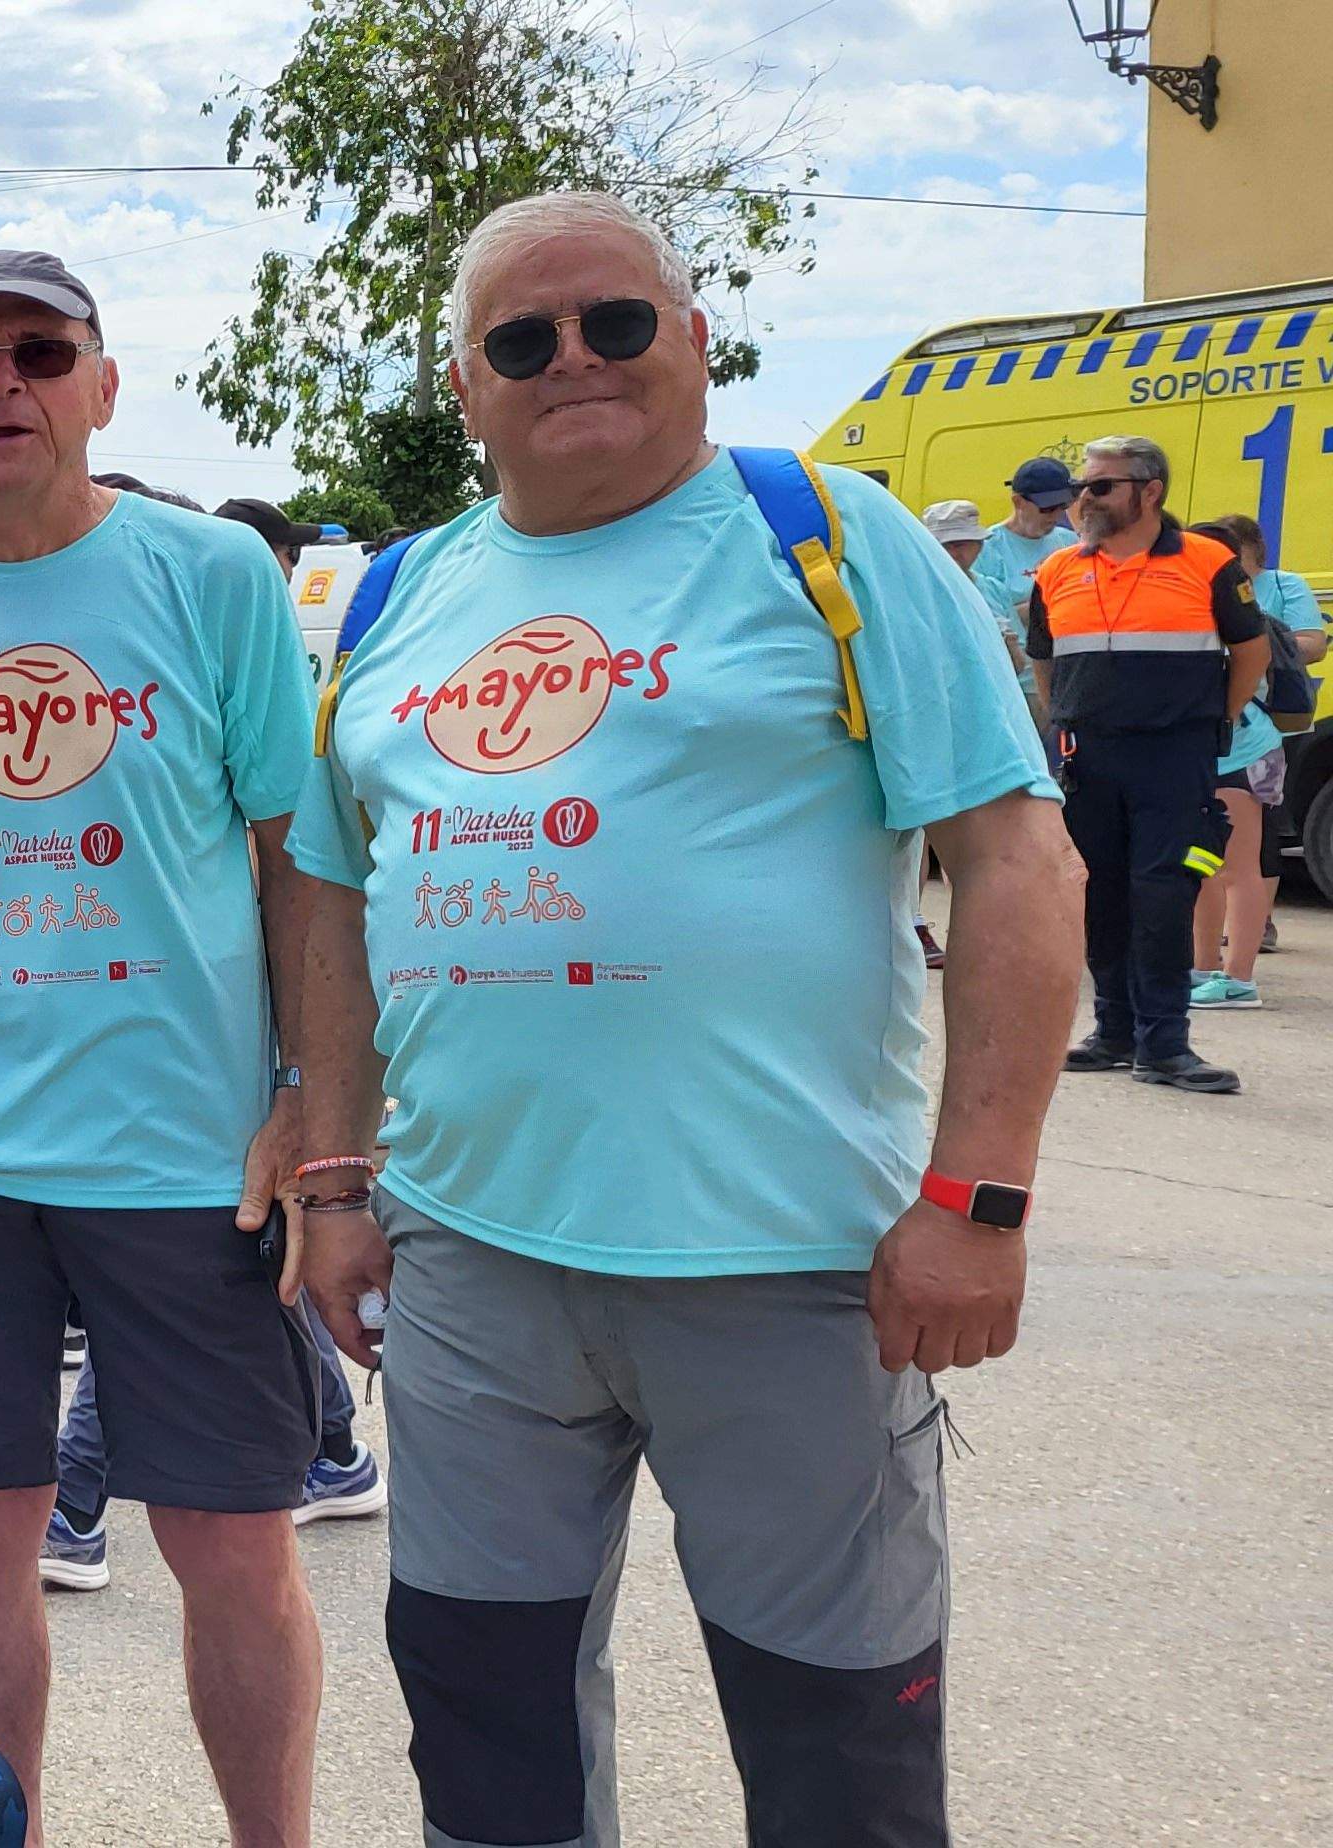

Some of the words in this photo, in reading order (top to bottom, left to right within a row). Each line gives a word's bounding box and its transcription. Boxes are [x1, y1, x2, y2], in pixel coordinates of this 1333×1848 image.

[1129, 359, 1305, 404] SOPORTE
[391, 643, 678, 736] +mayores
[453, 804, 537, 832] Marcha
[1, 829, 75, 854] Marcha
[451, 832, 488, 845] ASPACE
[493, 829, 534, 841] HUESCA
[507, 841, 533, 851] 2023
[4, 854, 38, 866] ASPACE
[41, 852, 76, 862] HUESCA
[54, 862, 77, 871] 2023
